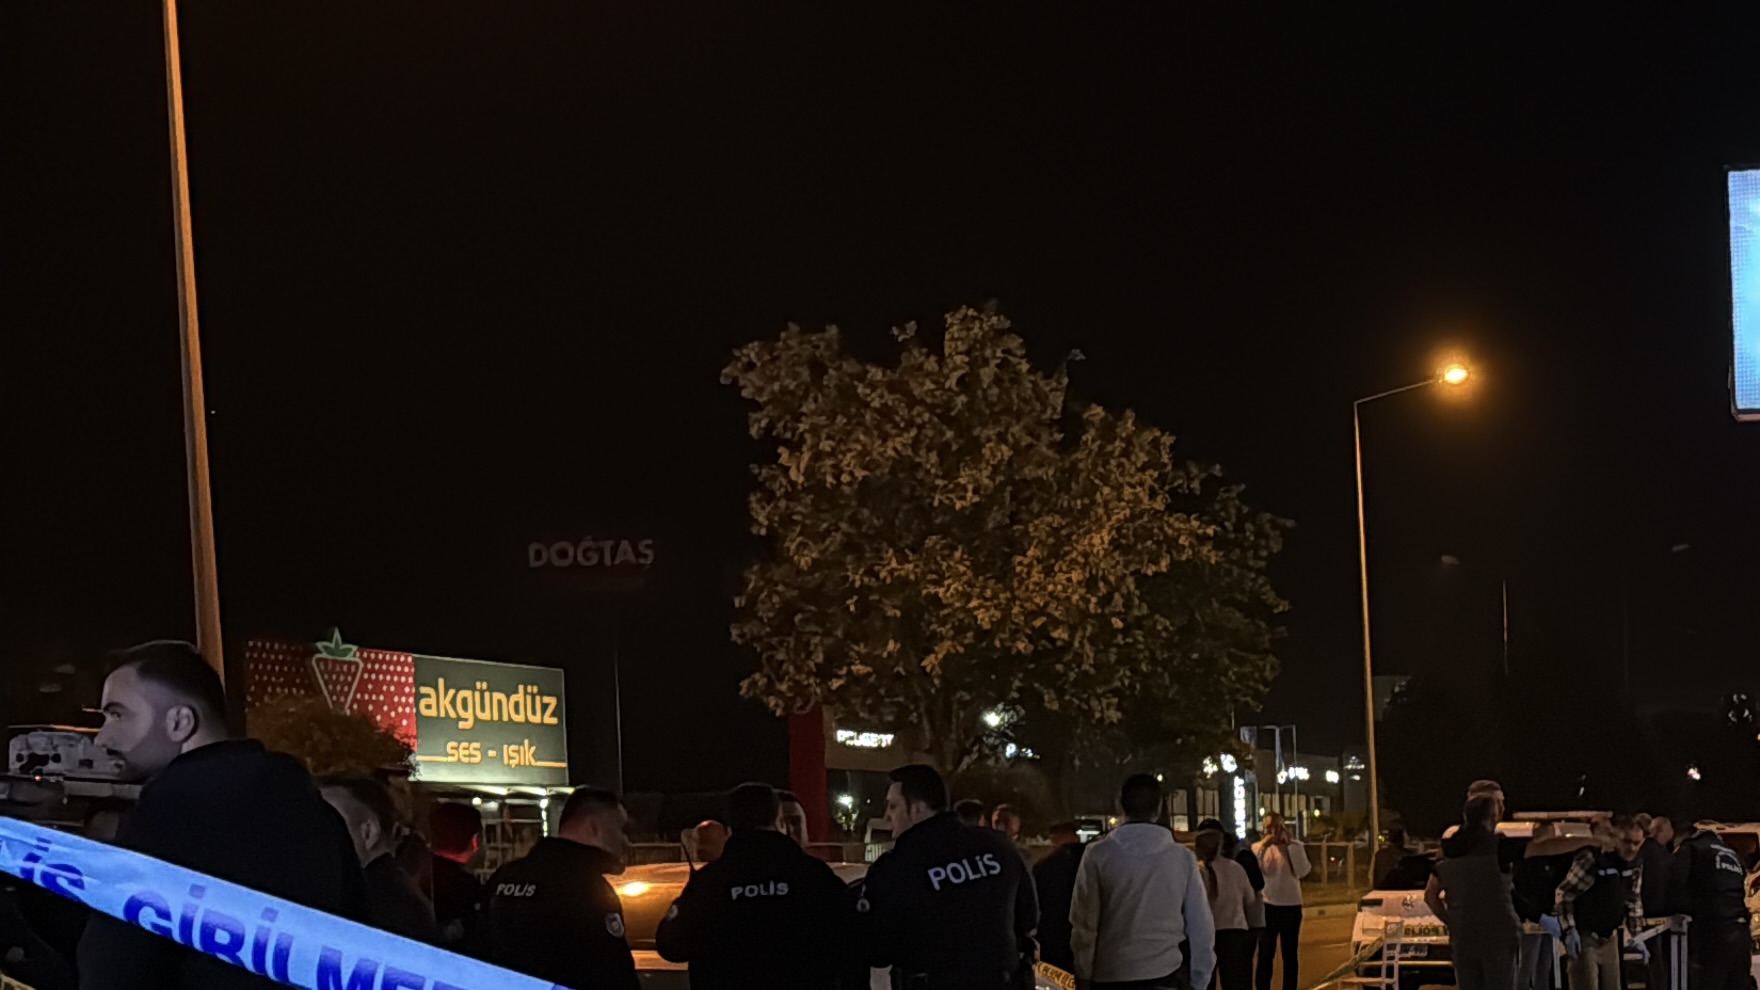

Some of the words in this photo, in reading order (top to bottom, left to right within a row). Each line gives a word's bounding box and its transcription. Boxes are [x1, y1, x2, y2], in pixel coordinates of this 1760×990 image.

[418, 677, 559, 730] akgündüz
[730, 879, 790, 901] POLİS
[927, 852, 1002, 893] POLİS
